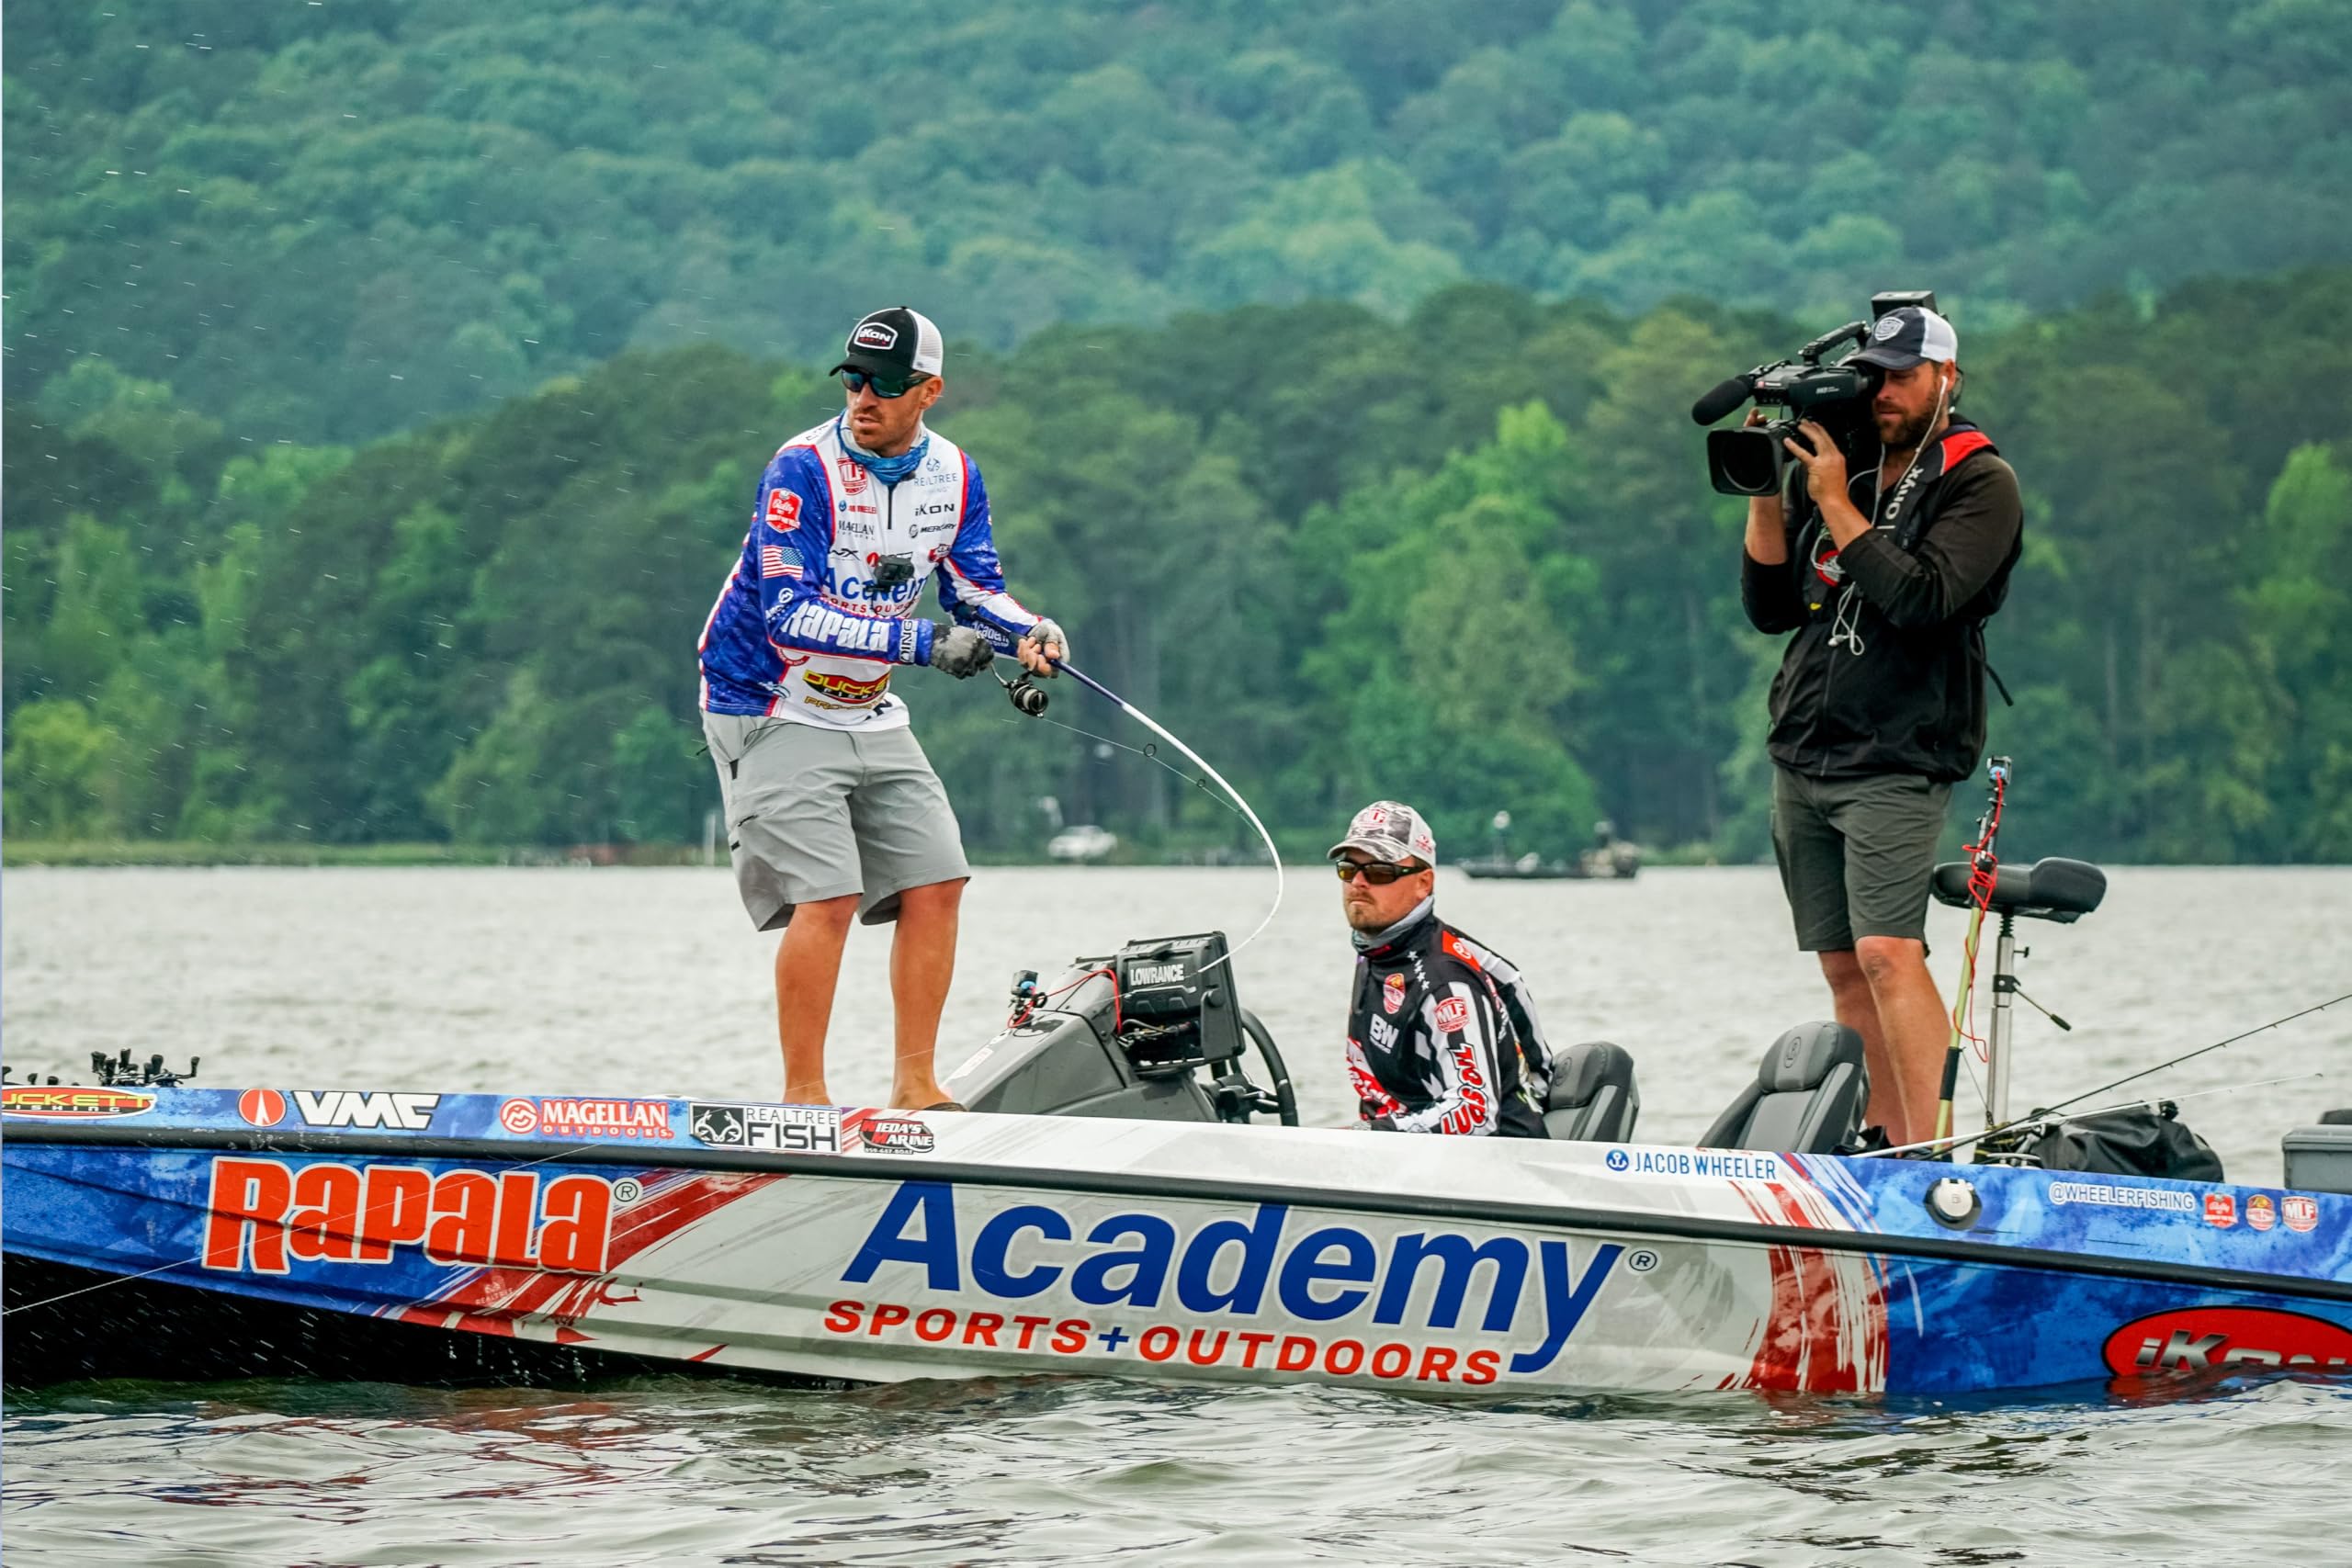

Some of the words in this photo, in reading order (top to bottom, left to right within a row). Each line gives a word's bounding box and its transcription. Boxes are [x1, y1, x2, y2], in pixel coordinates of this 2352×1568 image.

[1130, 964, 1184, 986] LOWRANCE
[1436, 1002, 1465, 1024] MLF
[1370, 1013, 1399, 1048] BW
[292, 1090, 441, 1130] VMC
[541, 1100, 669, 1127] MAGELLAN
[745, 1108, 837, 1125] REALTREE
[747, 1122, 837, 1152] FISH
[1634, 1152, 1690, 1175] JACOB
[1693, 1155, 1777, 1180] WHEELER
[2050, 1183, 2195, 1211] @WHEELERFISHING
[2285, 1202, 2316, 1220] MLF
